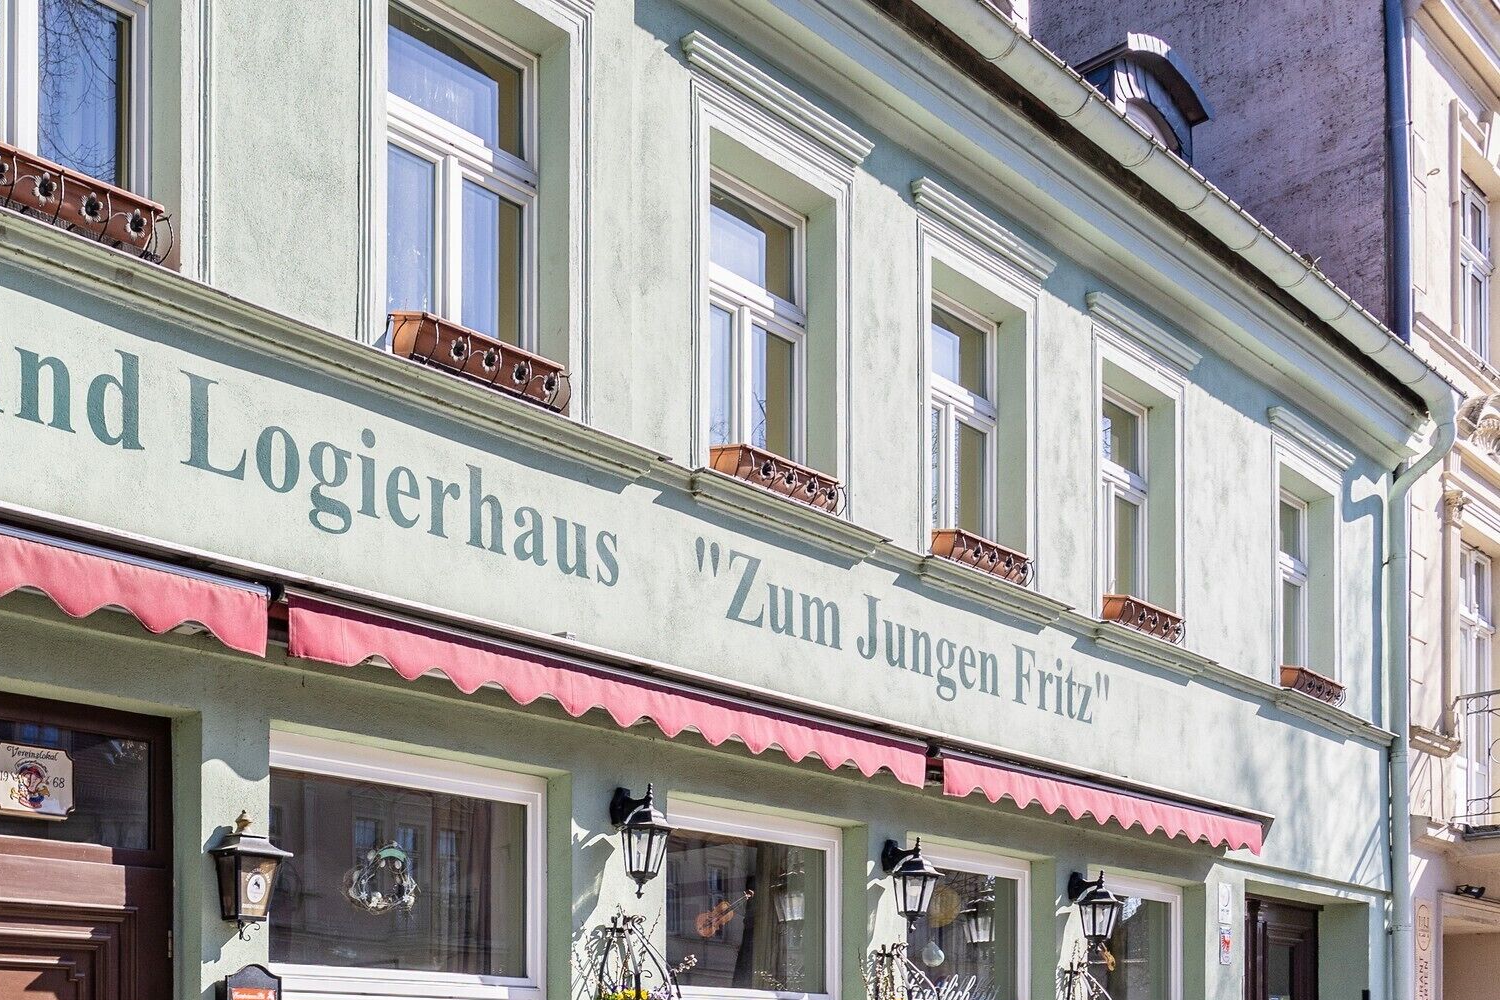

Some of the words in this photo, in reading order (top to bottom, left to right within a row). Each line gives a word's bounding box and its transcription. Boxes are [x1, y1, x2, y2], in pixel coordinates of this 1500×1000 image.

[180, 368, 620, 587] Logierhaus
[695, 536, 842, 650] "Zum
[856, 593, 1000, 702] Jungen
[1012, 643, 1110, 725] Fritz"
[52, 776, 66, 789] 68
